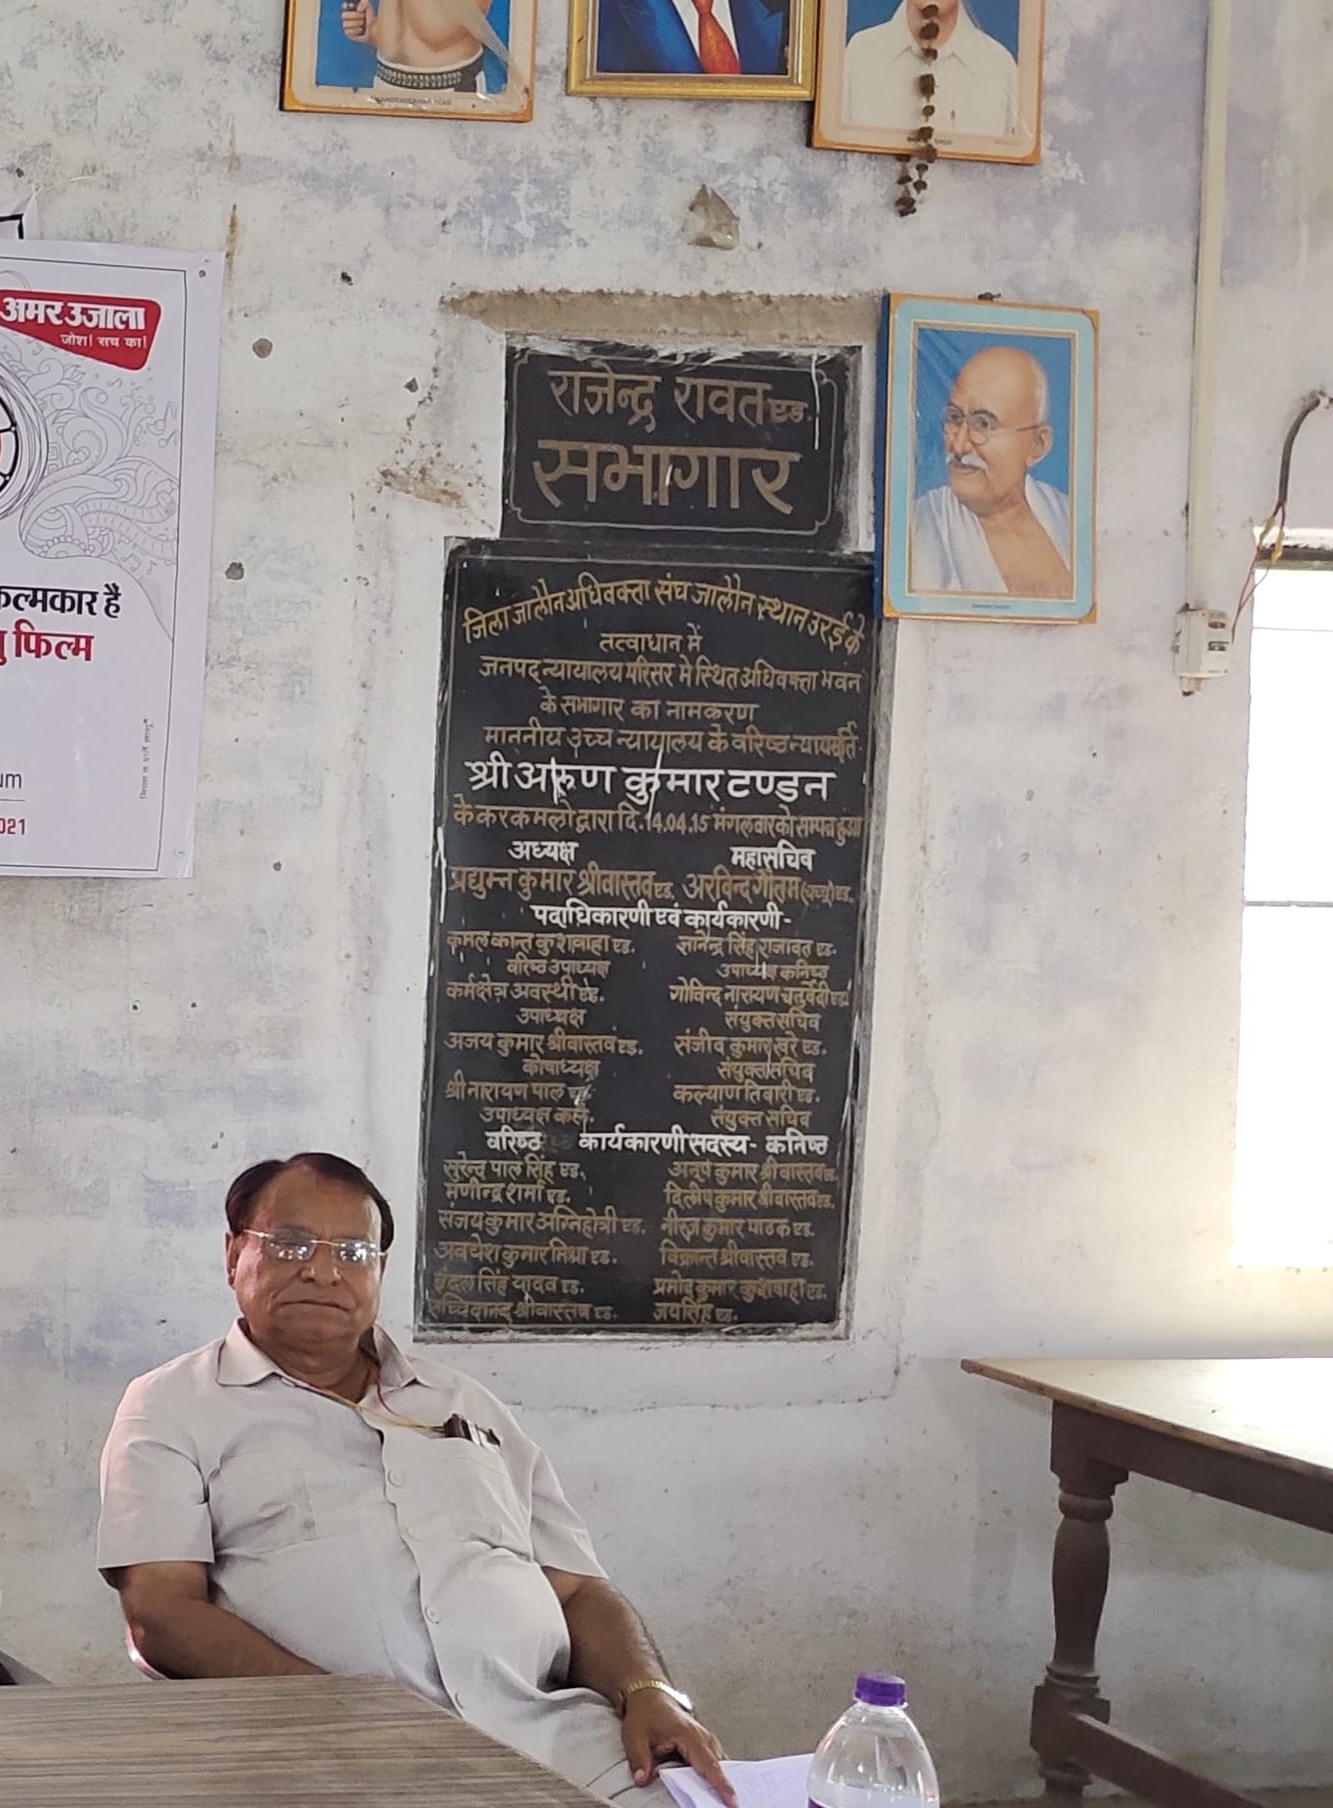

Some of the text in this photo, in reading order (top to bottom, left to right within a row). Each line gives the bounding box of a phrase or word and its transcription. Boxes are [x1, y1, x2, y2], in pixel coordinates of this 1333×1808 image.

[0, 296, 145, 330] अमर उजाला
[548, 359, 662, 433] राजेन्द्र
[674, 376, 773, 425] रावत
[534, 439, 803, 515] सभागार
[13, 619, 94, 661] फिल्म
[462, 606, 512, 644] जिला
[686, 623, 703, 652] में
[631, 700, 661, 720] का
[483, 716, 567, 747] माननीय
[708, 723, 728, 753] के
[464, 750, 513, 791] श्री
[727, 769, 837, 803] टण्डन
[508, 840, 579, 866] अध्यक्ष
[729, 839, 816, 871] महासचिव
[485, 1125, 543, 1154] वरिष्ठ
